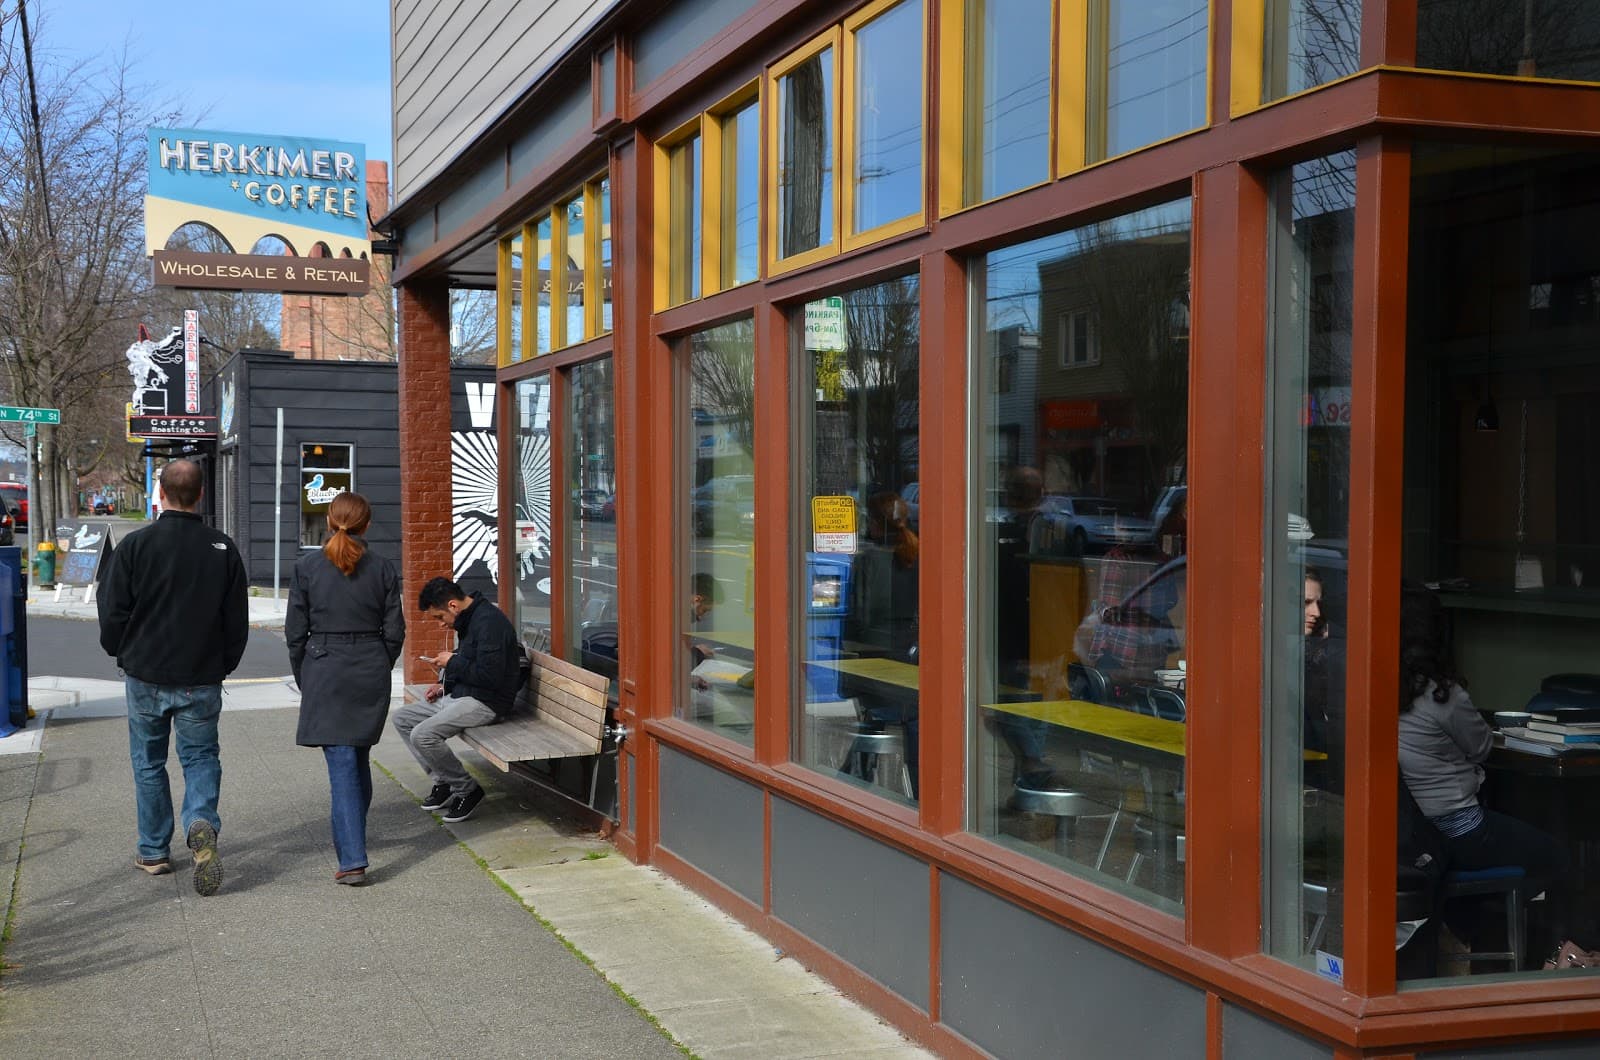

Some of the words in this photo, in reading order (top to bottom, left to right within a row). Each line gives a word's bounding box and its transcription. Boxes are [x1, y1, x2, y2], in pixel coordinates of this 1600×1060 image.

[159, 137, 358, 182] HERKIMER
[244, 181, 358, 218] COFFEE
[160, 261, 277, 280] WHOLESALE
[285, 267, 296, 280] &
[304, 267, 364, 283] RETAIL
[0, 409, 7, 418] N
[16, 409, 42, 420] 74th
[48, 412, 57, 421] St
[150, 418, 205, 426] Coffee
[151, 426, 191, 434] Roasting
